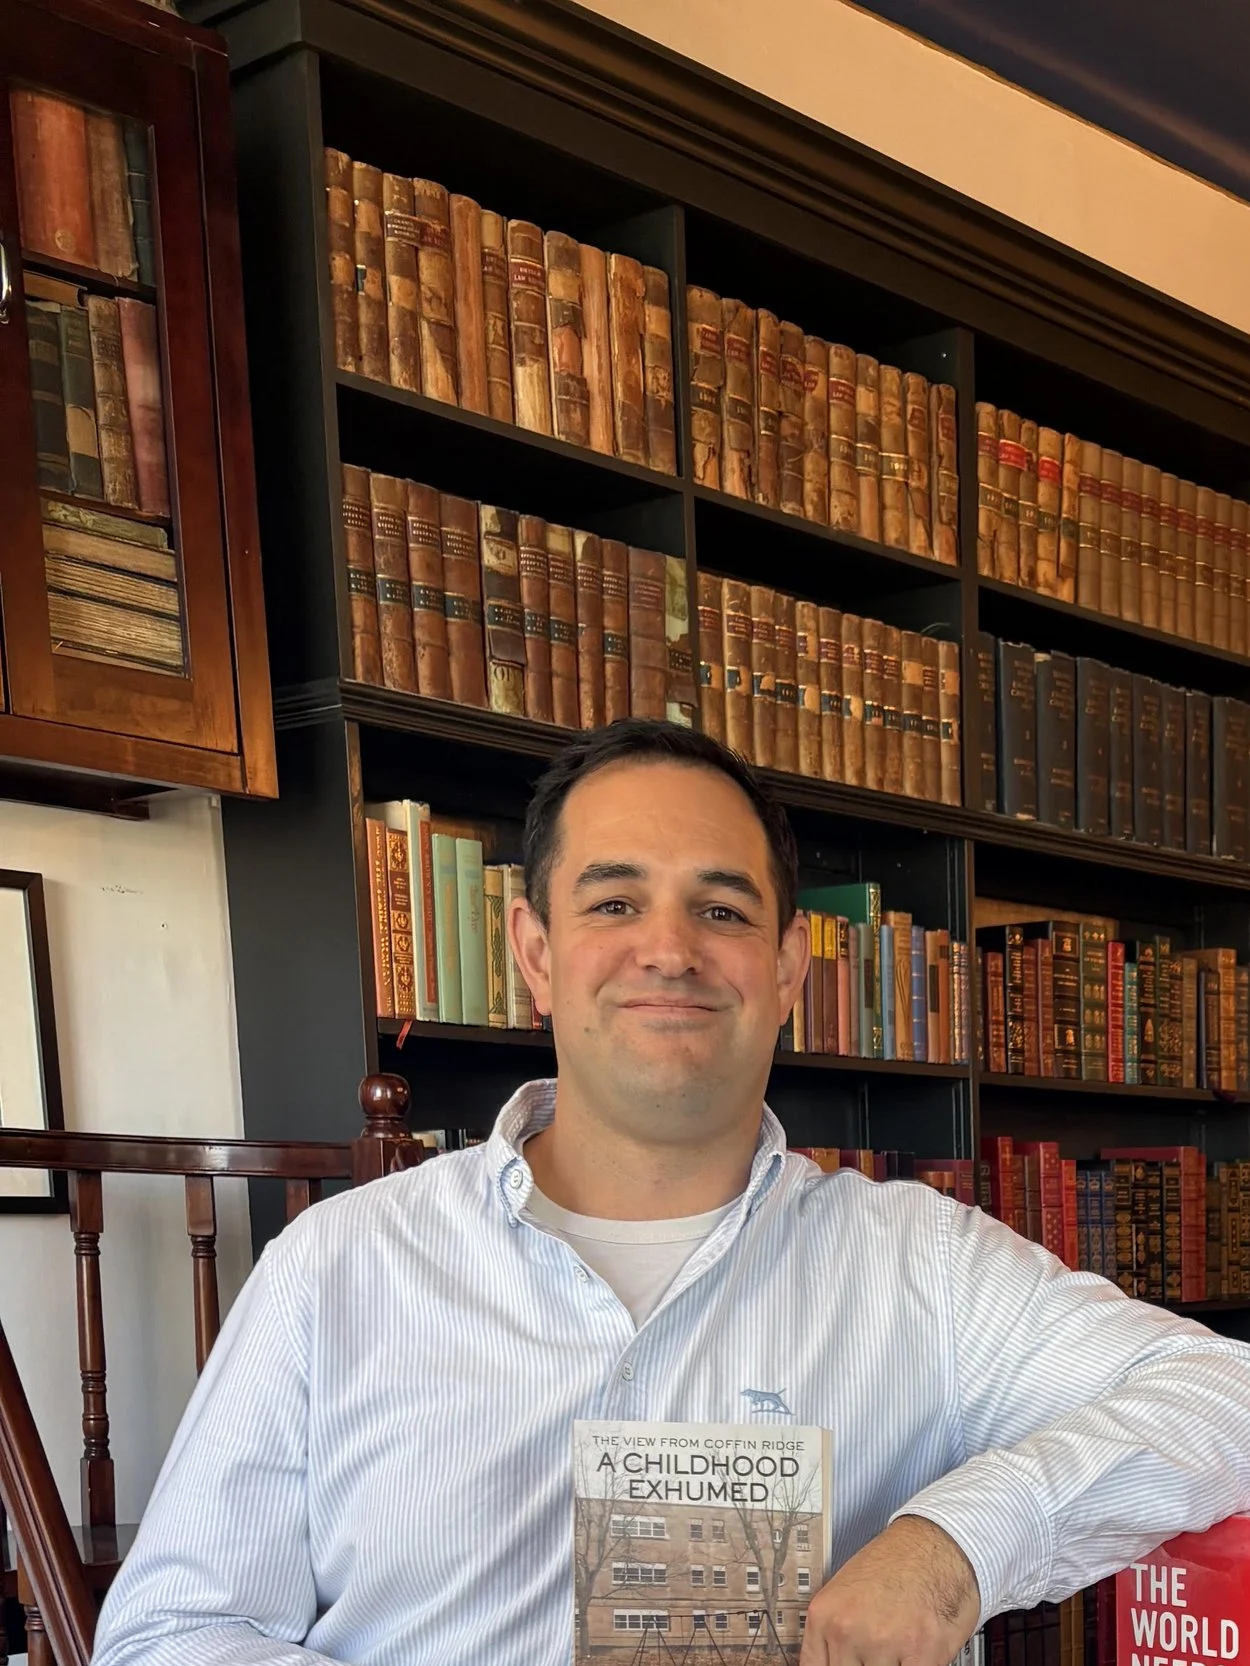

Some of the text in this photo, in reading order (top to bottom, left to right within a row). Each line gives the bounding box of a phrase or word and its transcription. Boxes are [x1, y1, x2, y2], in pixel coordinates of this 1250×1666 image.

[593, 1436, 804, 1450] THE VIEW FROM COFFIN RIDGE
[597, 1452, 799, 1477] A CHILDHOOD
[629, 1480, 769, 1502] EXHUMED
[1130, 1562, 1187, 1608] THE
[1130, 1607, 1239, 1661] WORLD
